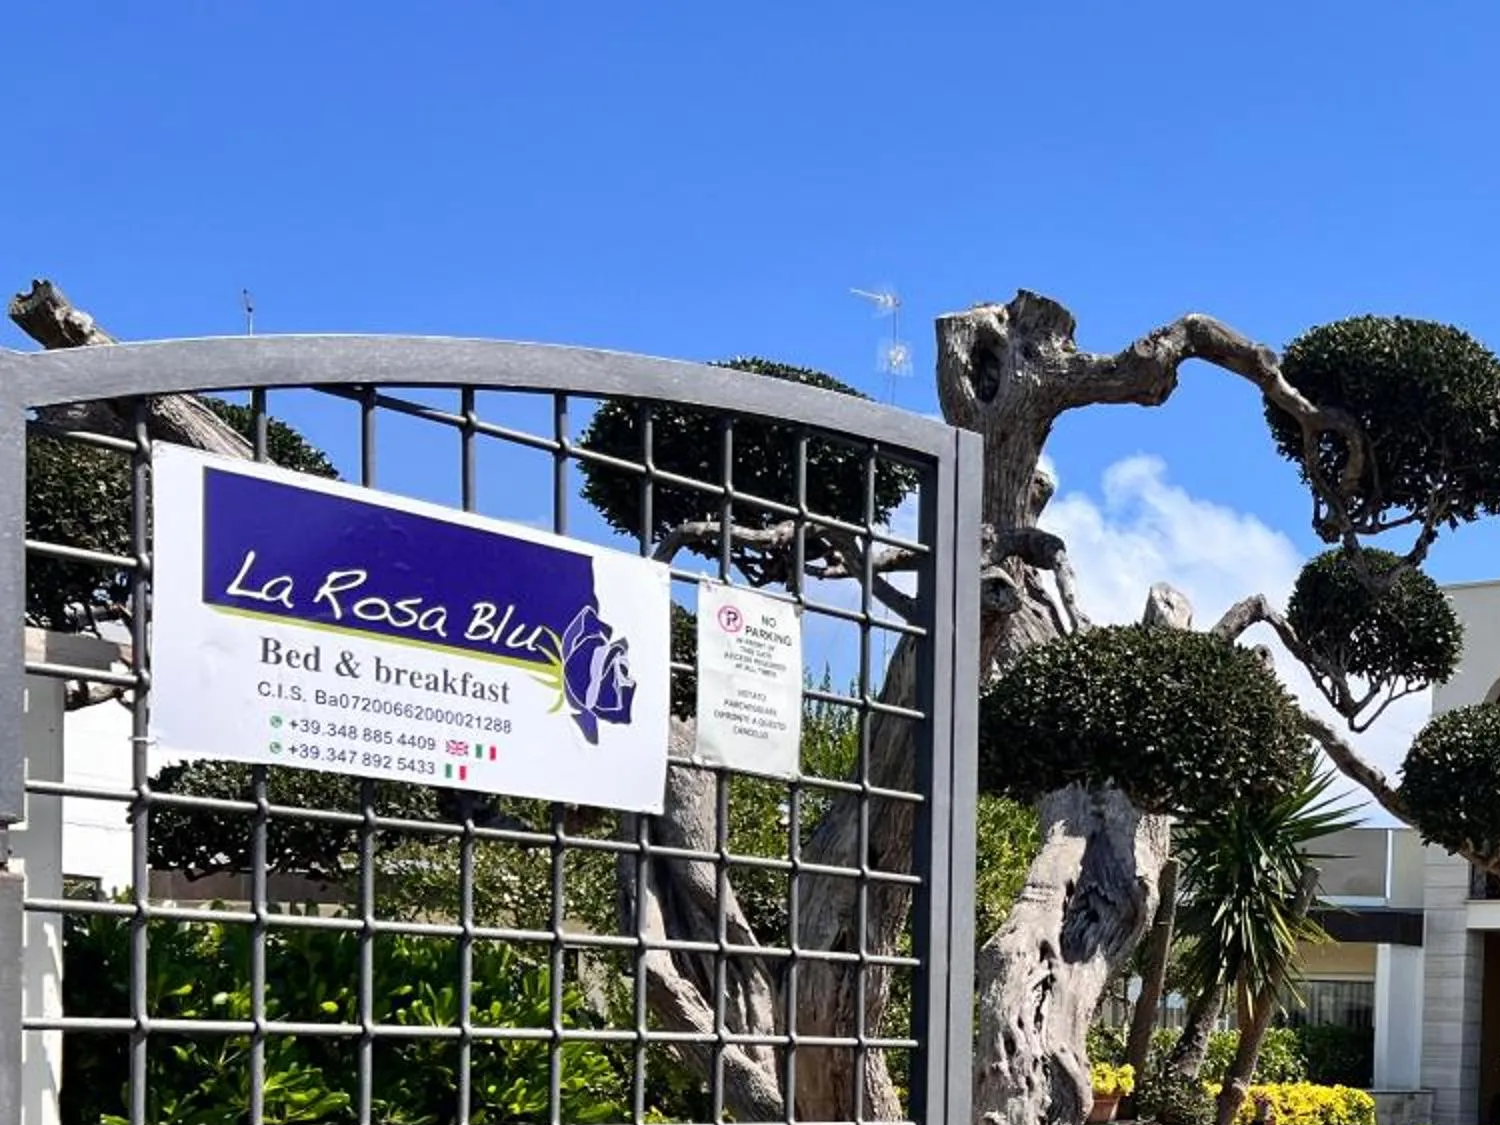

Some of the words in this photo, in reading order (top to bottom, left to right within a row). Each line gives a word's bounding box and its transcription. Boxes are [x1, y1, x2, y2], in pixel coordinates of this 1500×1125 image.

[226, 550, 294, 609] La
[313, 569, 448, 638] Rosa
[463, 602, 542, 651] Blu
[744, 625, 793, 647] PARKING
[761, 614, 777, 629] NO
[259, 636, 322, 674] Bed
[335, 650, 361, 679] &
[374, 656, 511, 704] breakfast
[257, 681, 306, 702] C.I.S.
[289, 718, 359, 740] +39.348
[362, 727, 393, 745] 885
[396, 732, 436, 751] 4409
[287, 744, 357, 764] +39.347
[361, 753, 393, 770] 892
[396, 756, 436, 775] 5433
